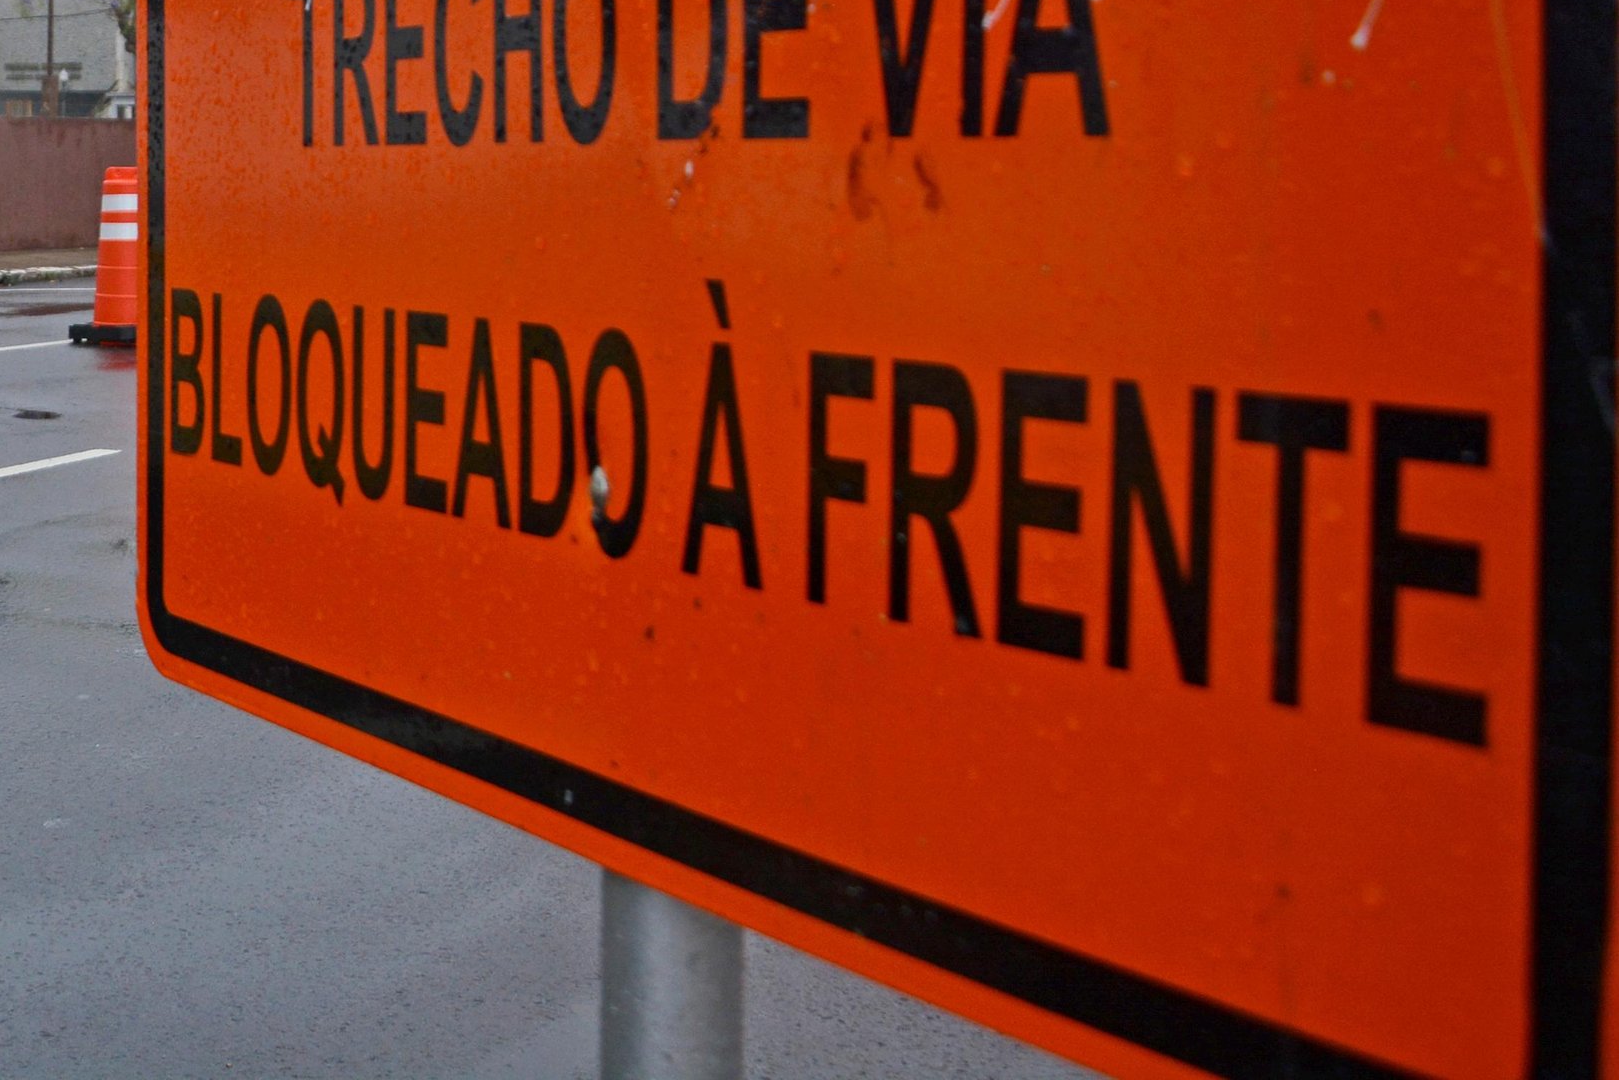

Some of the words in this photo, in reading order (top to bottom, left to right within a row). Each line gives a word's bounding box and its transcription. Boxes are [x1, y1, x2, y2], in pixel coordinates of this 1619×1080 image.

[168, 287, 648, 559] BLOQUEADO
[680, 278, 764, 591] À
[805, 350, 1492, 752] FRENTE
